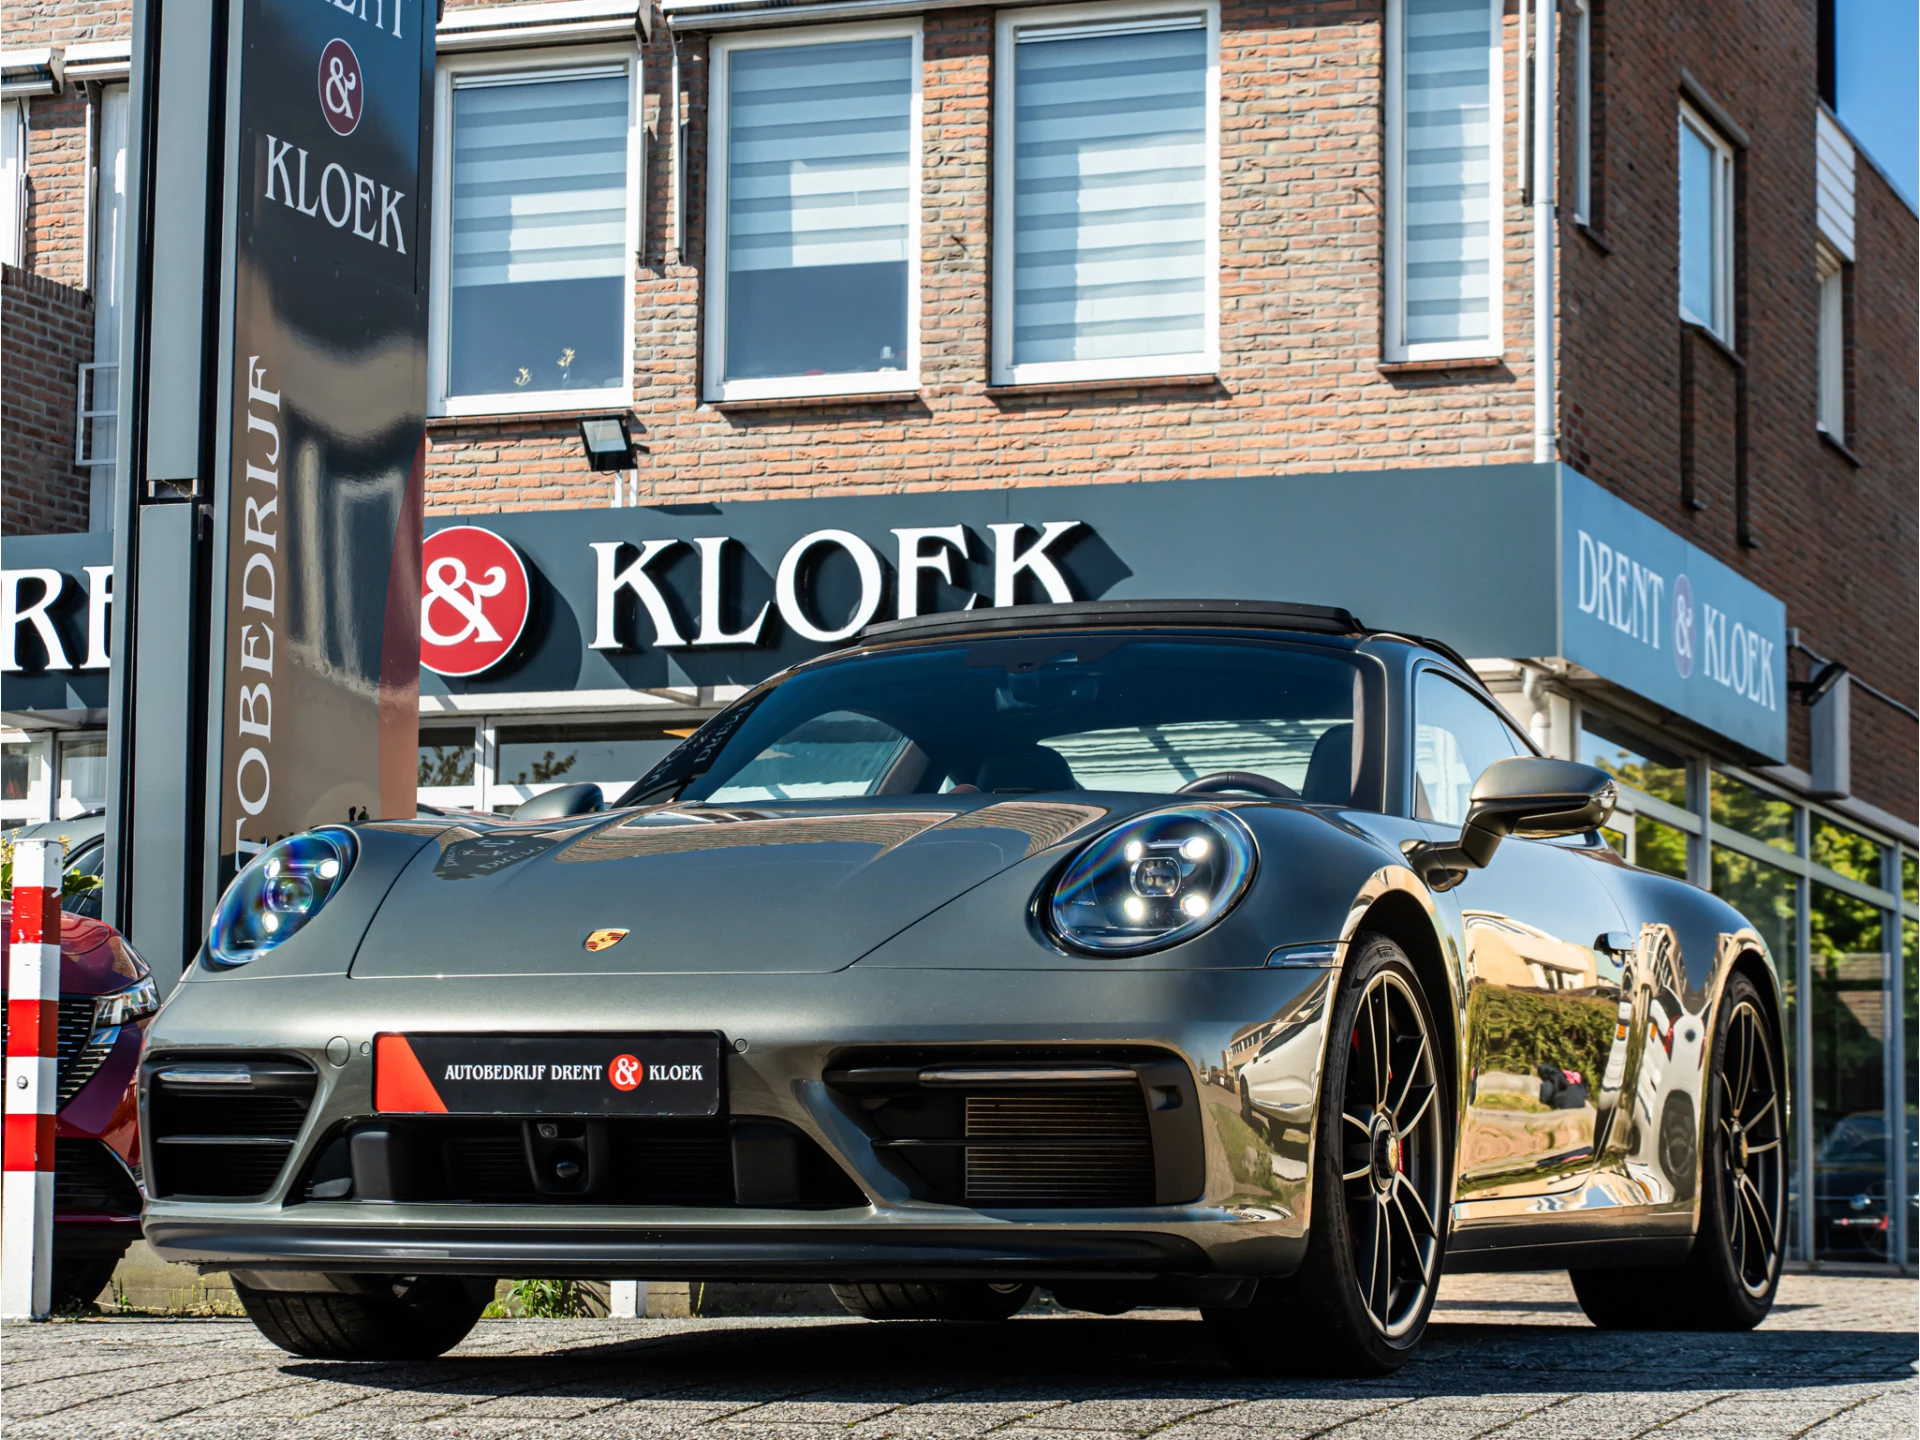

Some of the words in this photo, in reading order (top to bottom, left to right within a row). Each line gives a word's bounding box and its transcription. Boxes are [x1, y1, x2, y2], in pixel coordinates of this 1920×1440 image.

[325, 56, 357, 120] &
[264, 134, 407, 255] KLOEK
[420, 556, 507, 646] &
[588, 520, 1083, 650] KLOEK
[1577, 529, 1665, 650] DRENT
[1674, 594, 1693, 659] &
[1703, 603, 1777, 713] KLOEK
[444, 1064, 547, 1081] AUTOBEDRIJF
[550, 1064, 603, 1081] DRENT
[614, 1057, 639, 1086] &
[649, 1064, 703, 1081] KLOEK
